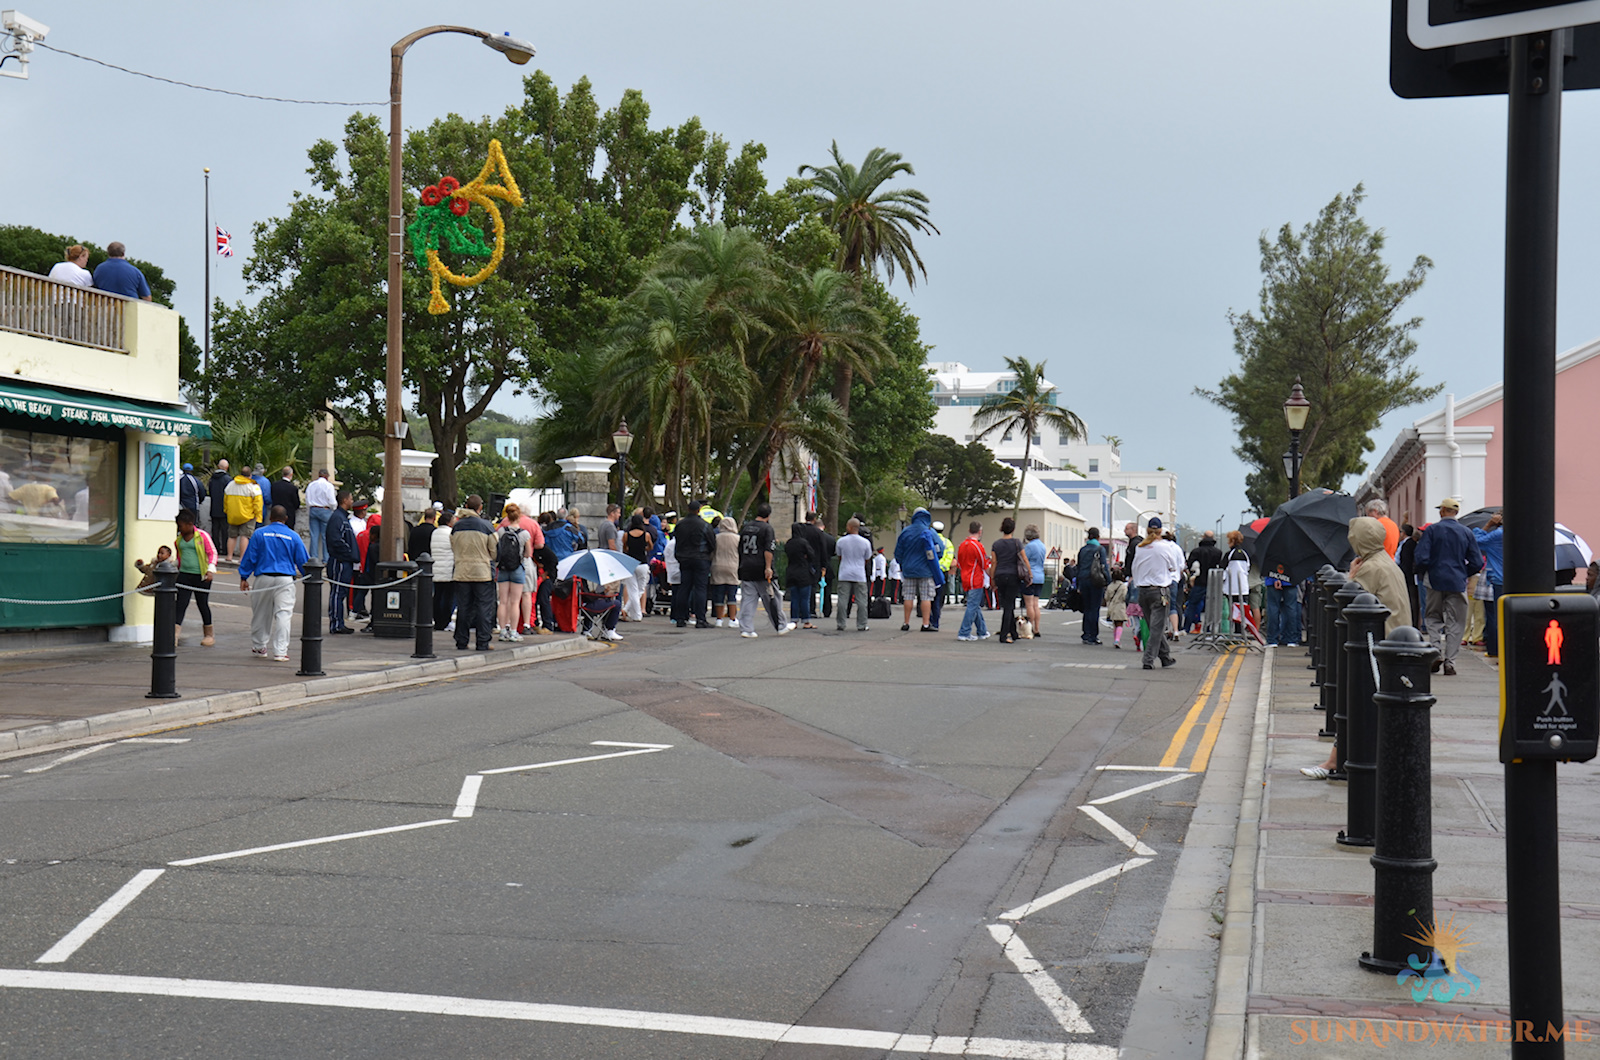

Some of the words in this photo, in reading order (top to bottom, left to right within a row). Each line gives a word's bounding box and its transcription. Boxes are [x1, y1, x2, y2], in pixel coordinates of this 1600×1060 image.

[12, 398, 27, 412] THE
[28, 401, 52, 415] BEACH
[167, 421, 172, 431] &
[173, 422, 192, 434] MORE
[742, 534, 758, 555] 24
[1558, 723, 1577, 731] signal
